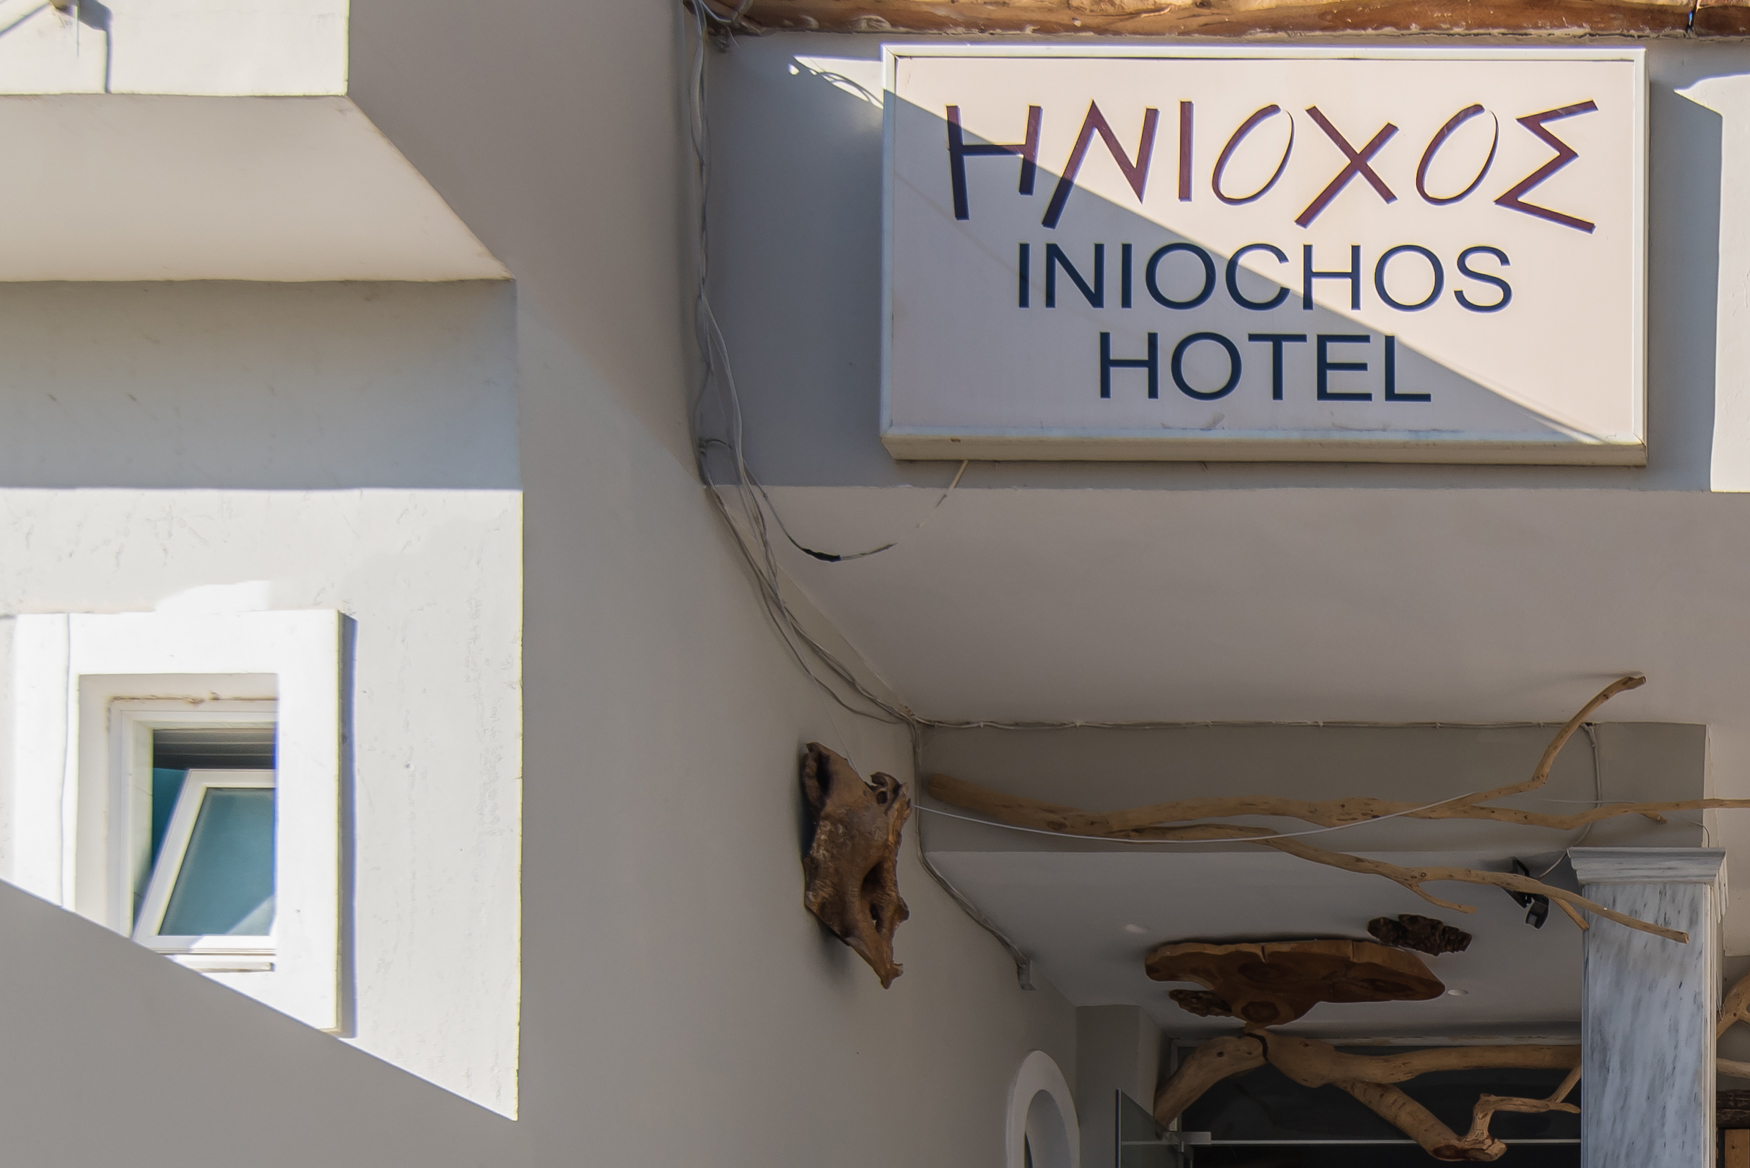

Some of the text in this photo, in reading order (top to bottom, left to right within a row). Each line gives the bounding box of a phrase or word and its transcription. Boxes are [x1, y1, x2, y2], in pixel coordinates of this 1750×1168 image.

[945, 100, 1599, 233] ΗΝΙΟΧΟΣ
[1018, 242, 1512, 313] INIOCHOS
[1099, 331, 1431, 402] HOTEL
